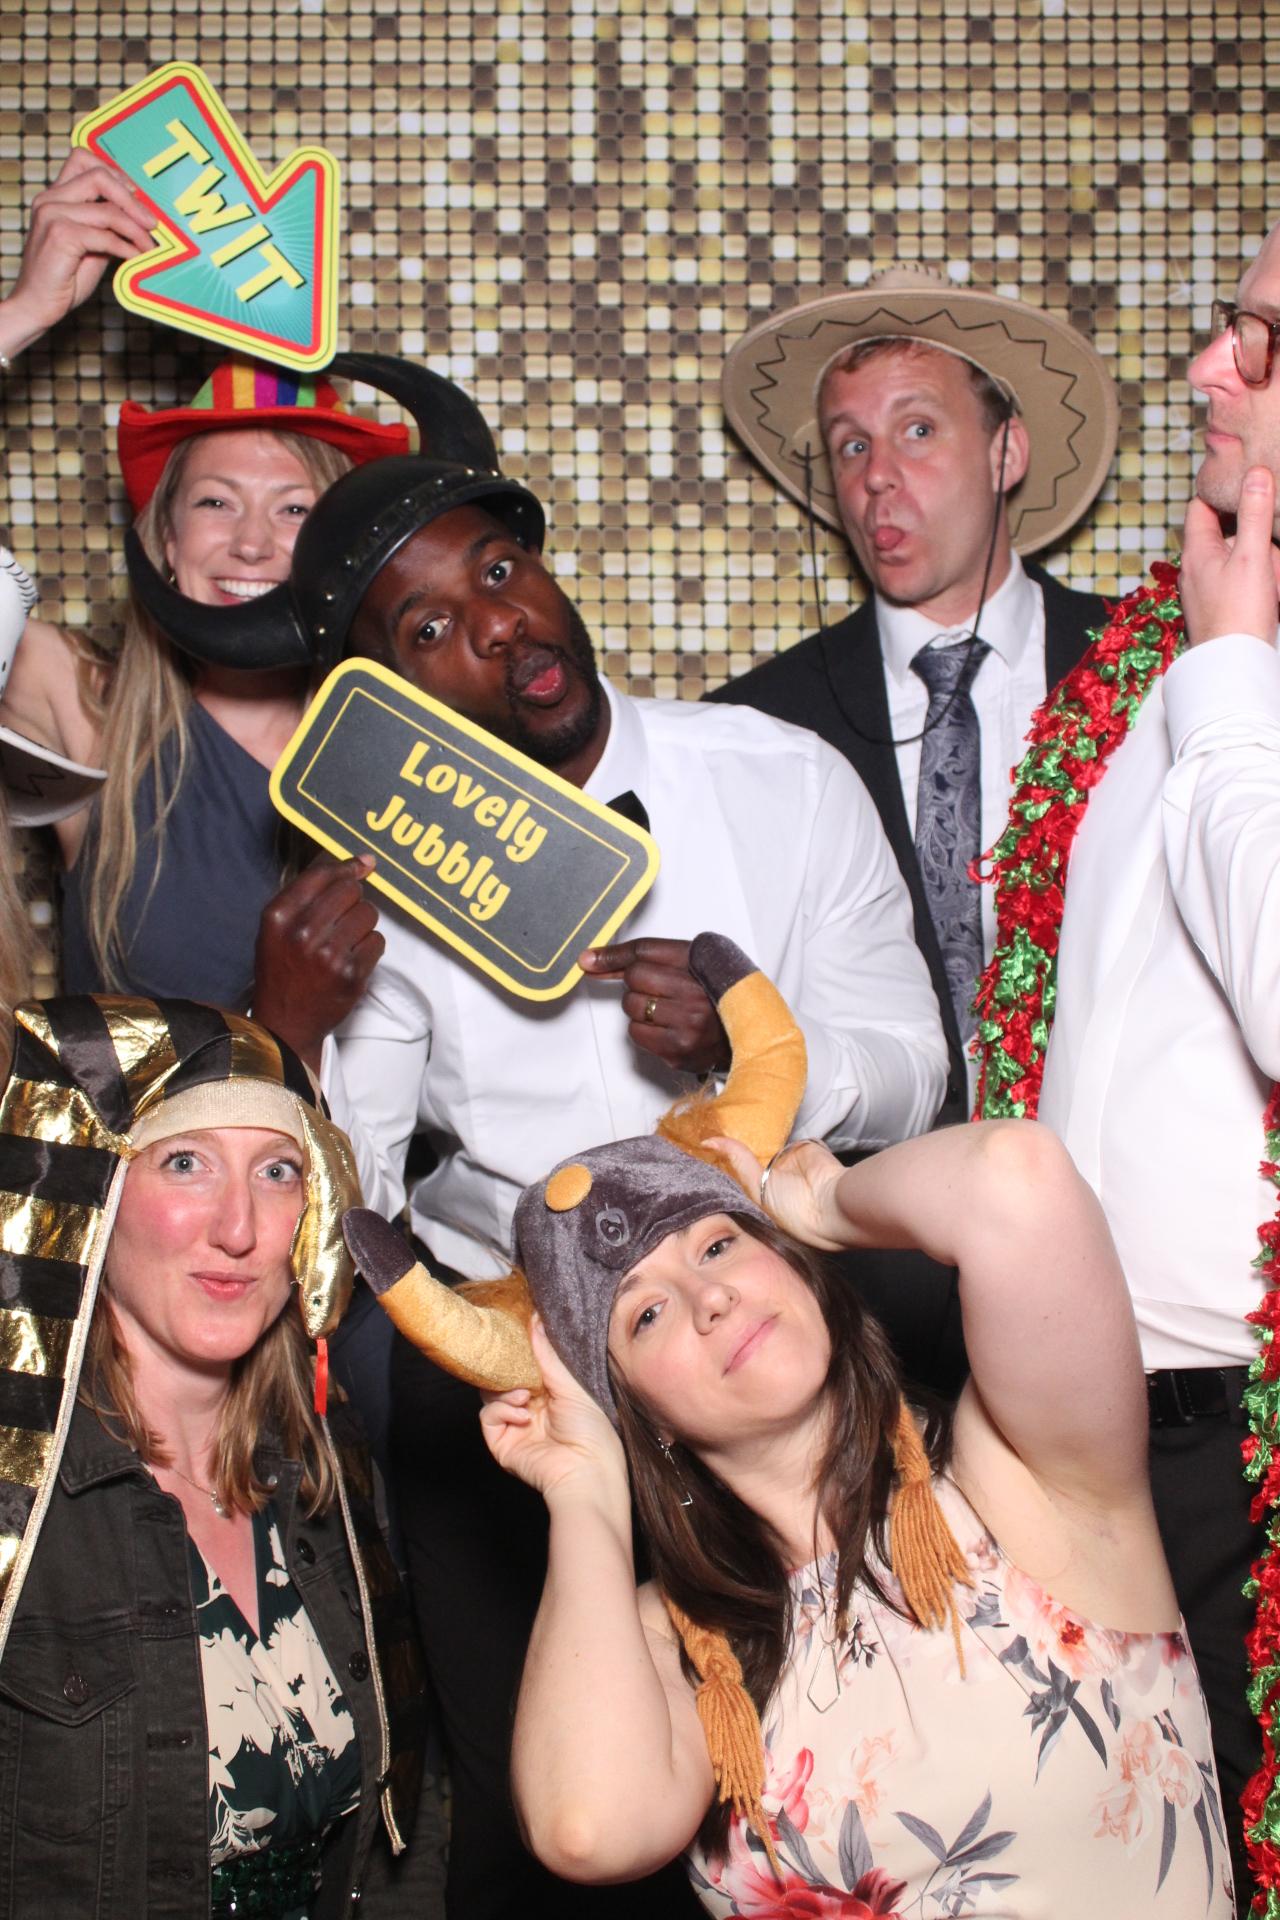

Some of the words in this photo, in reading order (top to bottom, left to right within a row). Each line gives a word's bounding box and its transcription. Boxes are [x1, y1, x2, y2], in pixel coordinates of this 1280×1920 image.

[143, 119, 306, 303] TWIT
[366, 795, 511, 921] Jubbly
[400, 741, 548, 863] Lovely
